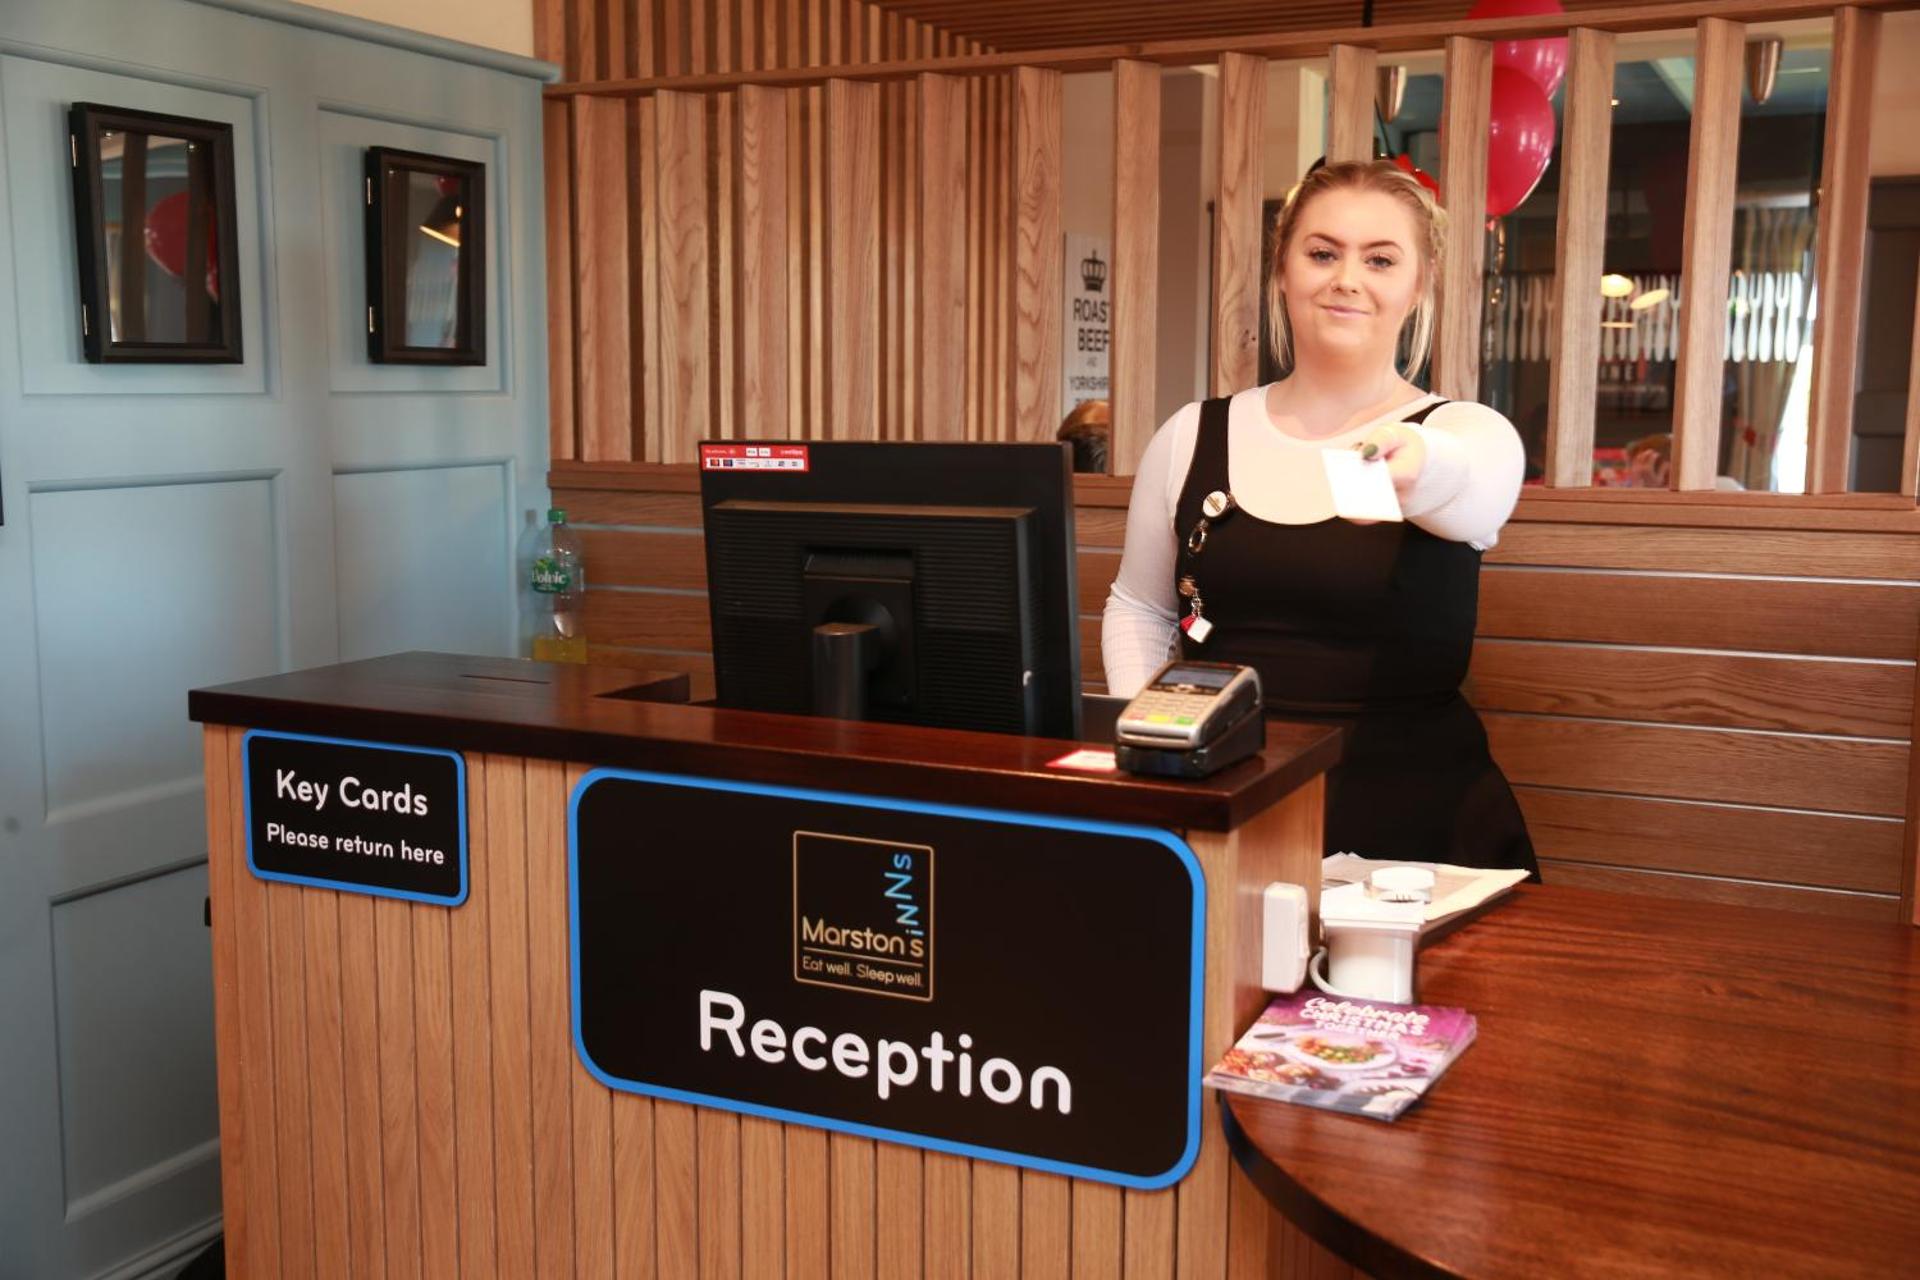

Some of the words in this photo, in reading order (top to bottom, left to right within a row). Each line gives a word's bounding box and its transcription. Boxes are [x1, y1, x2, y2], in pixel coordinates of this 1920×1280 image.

[1073, 298, 1109, 322] ROAS
[276, 768, 328, 811] Key
[339, 776, 428, 816] Cards
[266, 822, 329, 849] Please
[335, 835, 393, 858] return
[401, 840, 445, 865] here
[802, 955, 824, 971] Eat
[856, 963, 894, 984] Sleep
[699, 989, 1072, 1115] Reception
